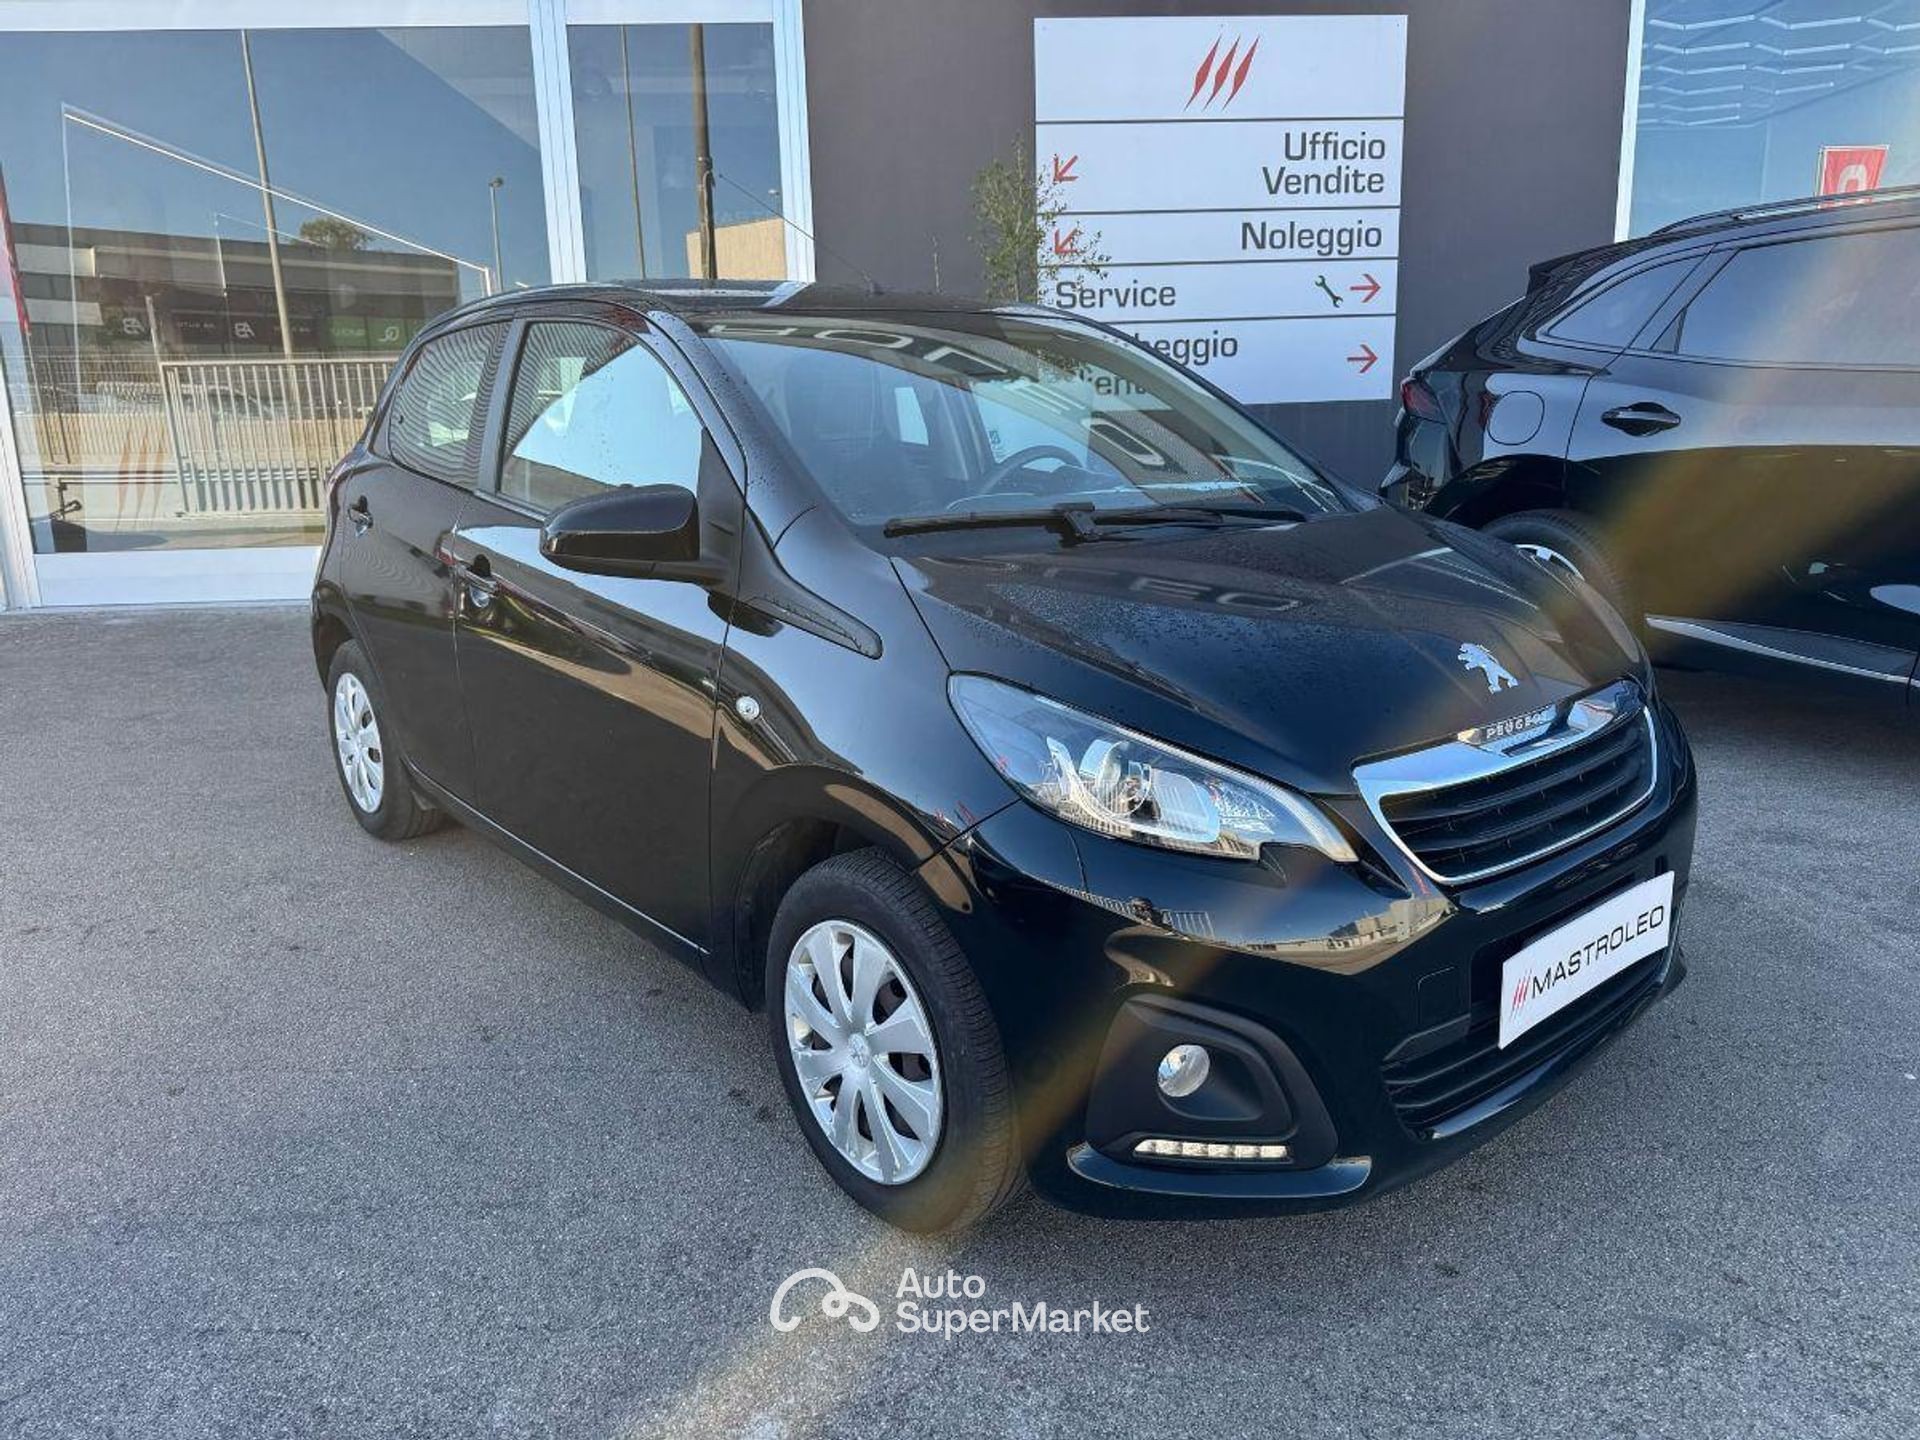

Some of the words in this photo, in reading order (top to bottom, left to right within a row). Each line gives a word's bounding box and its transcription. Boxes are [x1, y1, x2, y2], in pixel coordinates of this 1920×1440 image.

[1284, 132, 1386, 162] Ufficio
[1262, 166, 1384, 195] Vendite
[1241, 220, 1383, 256] Noleggio
[1056, 280, 1176, 308] Service
[1486, 713, 1546, 739] PEUGEO
[1532, 905, 1664, 999] MASTROLEO
